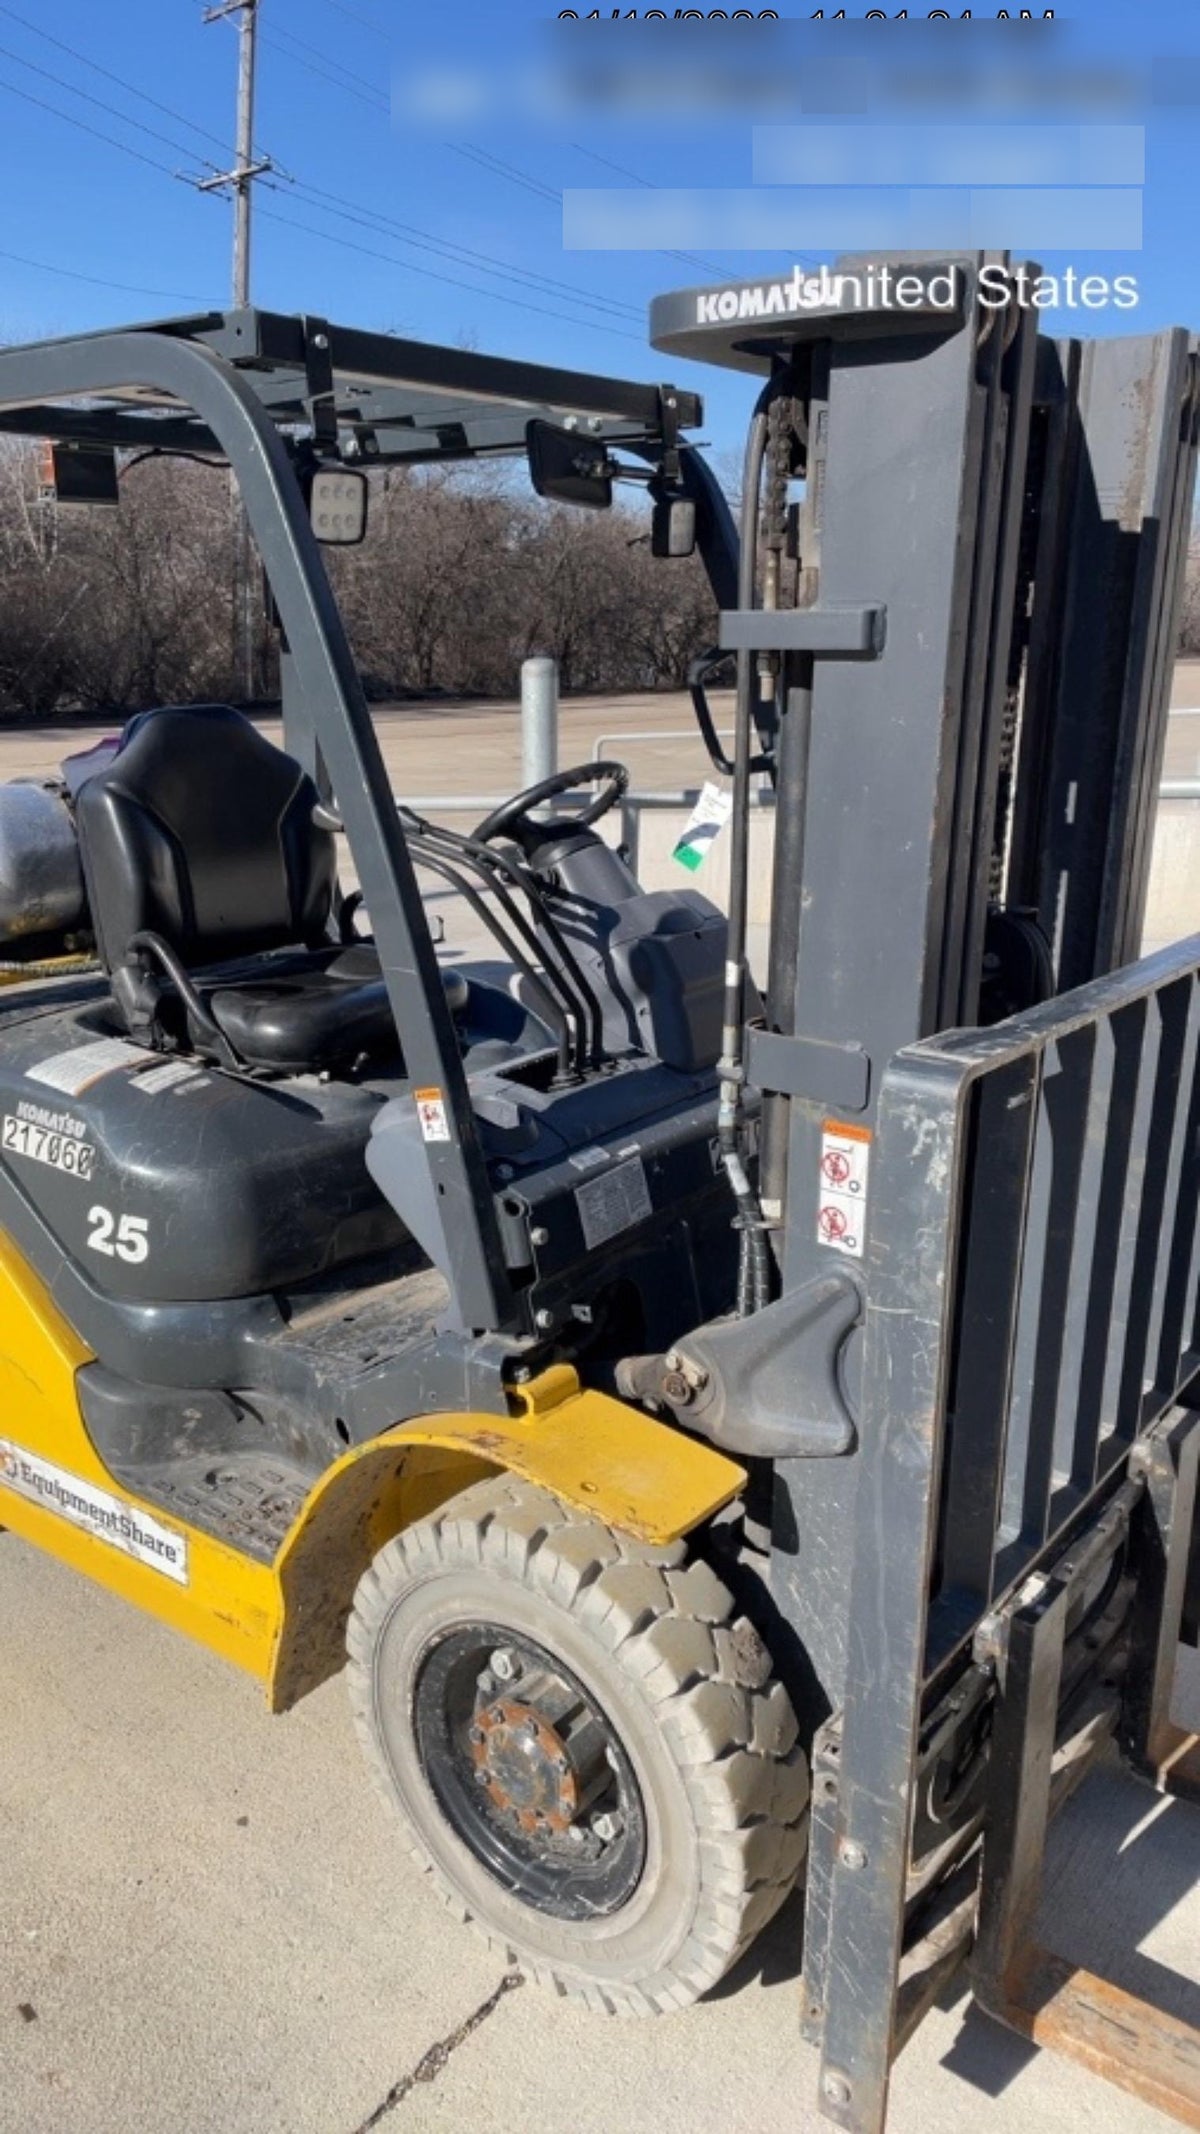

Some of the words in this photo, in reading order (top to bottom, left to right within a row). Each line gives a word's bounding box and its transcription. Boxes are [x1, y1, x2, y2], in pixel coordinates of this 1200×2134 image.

[696, 271, 843, 324] KOMATSU
[16, 1101, 86, 1138] KOMATSU
[87, 1205, 148, 1264] 25
[20, 1461, 177, 1563] EquipmentShare
